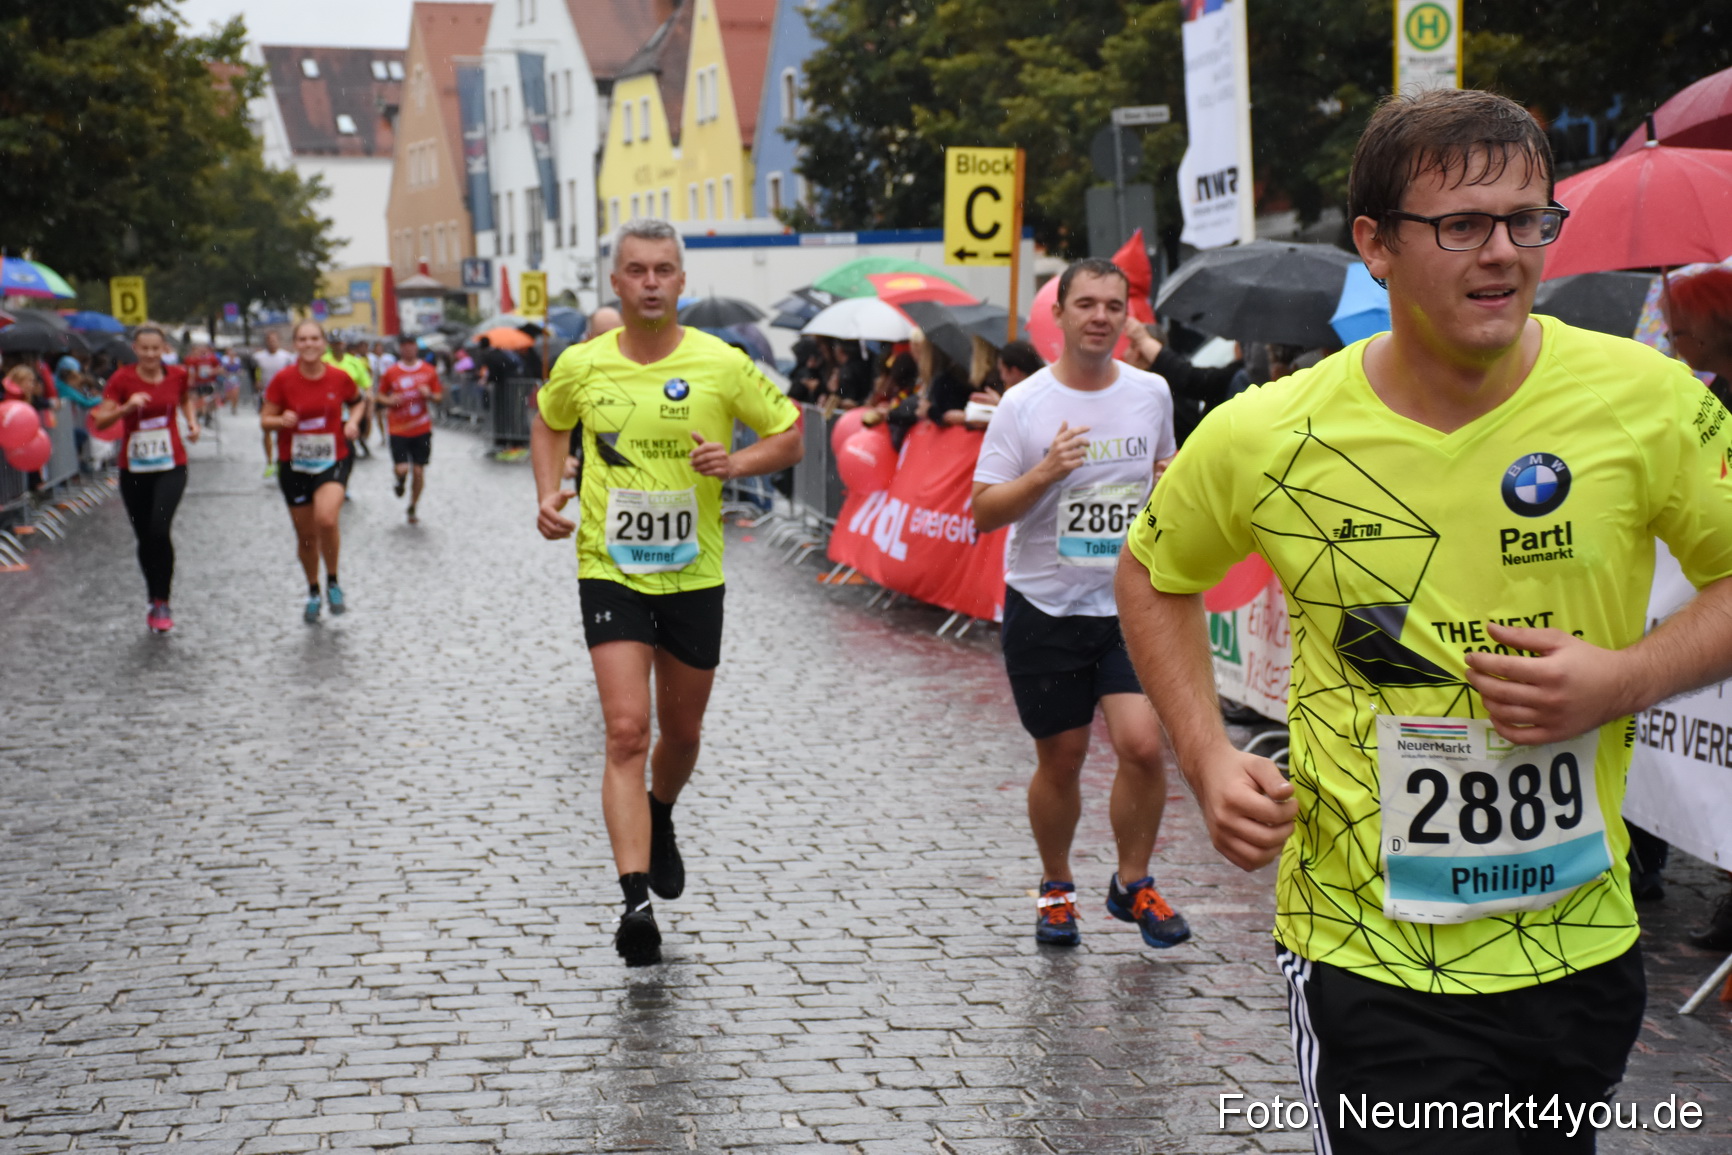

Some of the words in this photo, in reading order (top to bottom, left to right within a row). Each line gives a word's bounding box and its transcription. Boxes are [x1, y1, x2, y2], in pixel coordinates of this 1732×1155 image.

[956, 154, 1015, 175] Block
[965, 186, 1001, 240] C
[121, 292, 136, 314] D
[526, 285, 540, 307] D
[630, 440, 649, 449] THE
[652, 439, 679, 449] NEXT
[642, 450, 659, 459] 100
[1507, 453, 1566, 478] BMW
[615, 511, 692, 541] 2910
[1499, 520, 1573, 553] Partl
[630, 548, 676, 562] Werner
[1501, 547, 1574, 566] Neumarkt
[1431, 620, 1485, 643] THE
[1397, 739, 1472, 755] NeuerMarkt
[1406, 751, 1583, 845] 2889
[1392, 838, 1401, 852] D
[1451, 863, 1556, 895] Philipp
